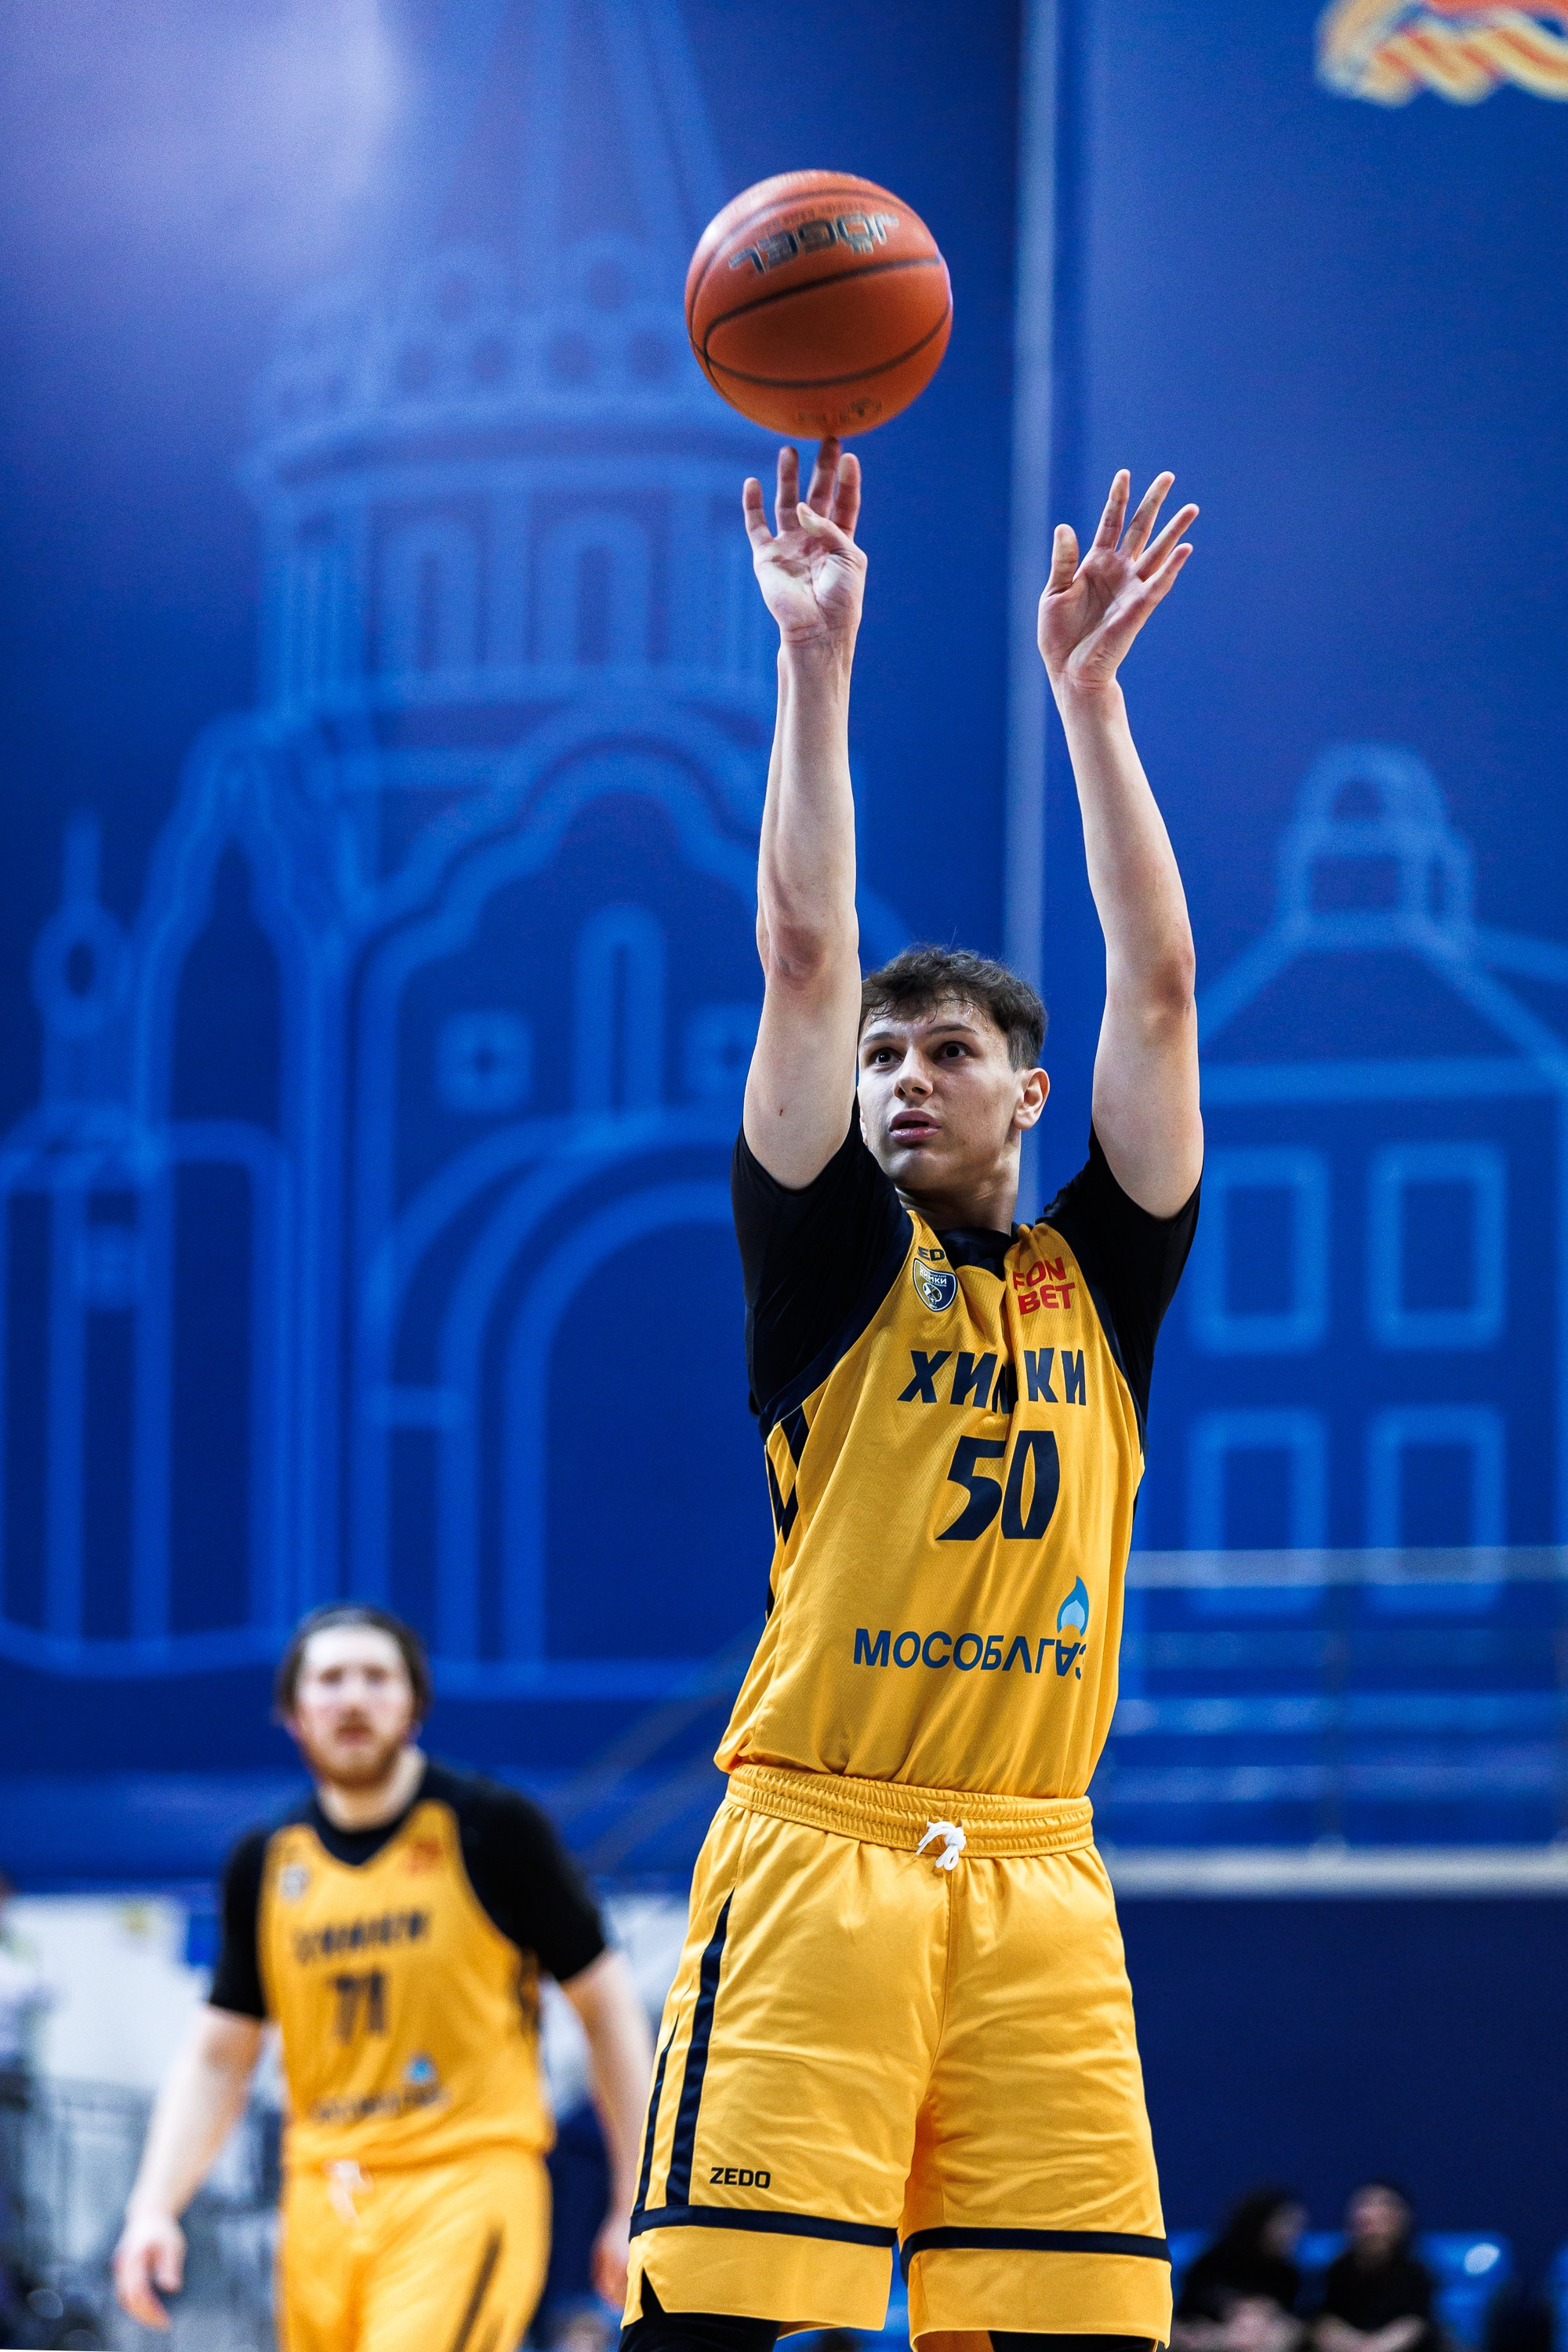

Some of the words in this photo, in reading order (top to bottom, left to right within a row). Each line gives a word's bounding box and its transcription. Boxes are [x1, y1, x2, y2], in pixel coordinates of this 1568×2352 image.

[1012, 1257, 1065, 1290] FON
[1018, 1283, 1076, 1316] BET
[935, 1430, 1061, 1541] 50
[324, 1965, 390, 2045] 71
[710, 2167, 771, 2189] ZEDO
